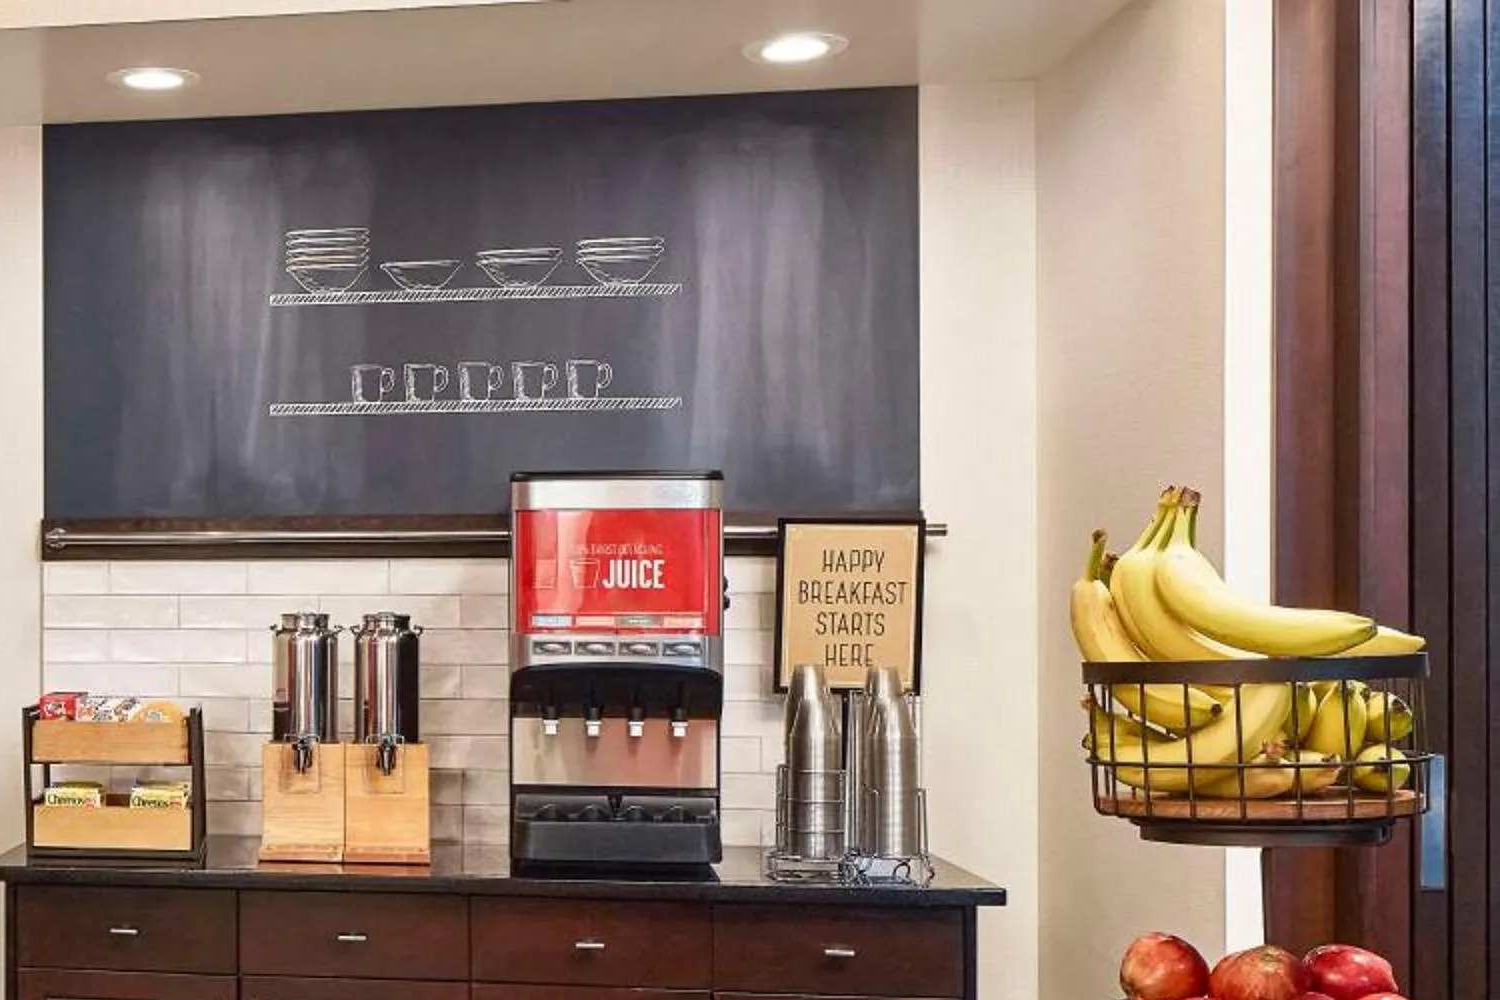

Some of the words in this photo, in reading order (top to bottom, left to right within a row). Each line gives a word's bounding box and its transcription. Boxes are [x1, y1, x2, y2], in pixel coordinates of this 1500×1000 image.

[822, 549, 885, 573] HAPPY
[602, 559, 665, 589] JUICE
[798, 580, 909, 605] BREAKFAST
[815, 611, 885, 636] STARTS
[825, 643, 874, 667] HERE
